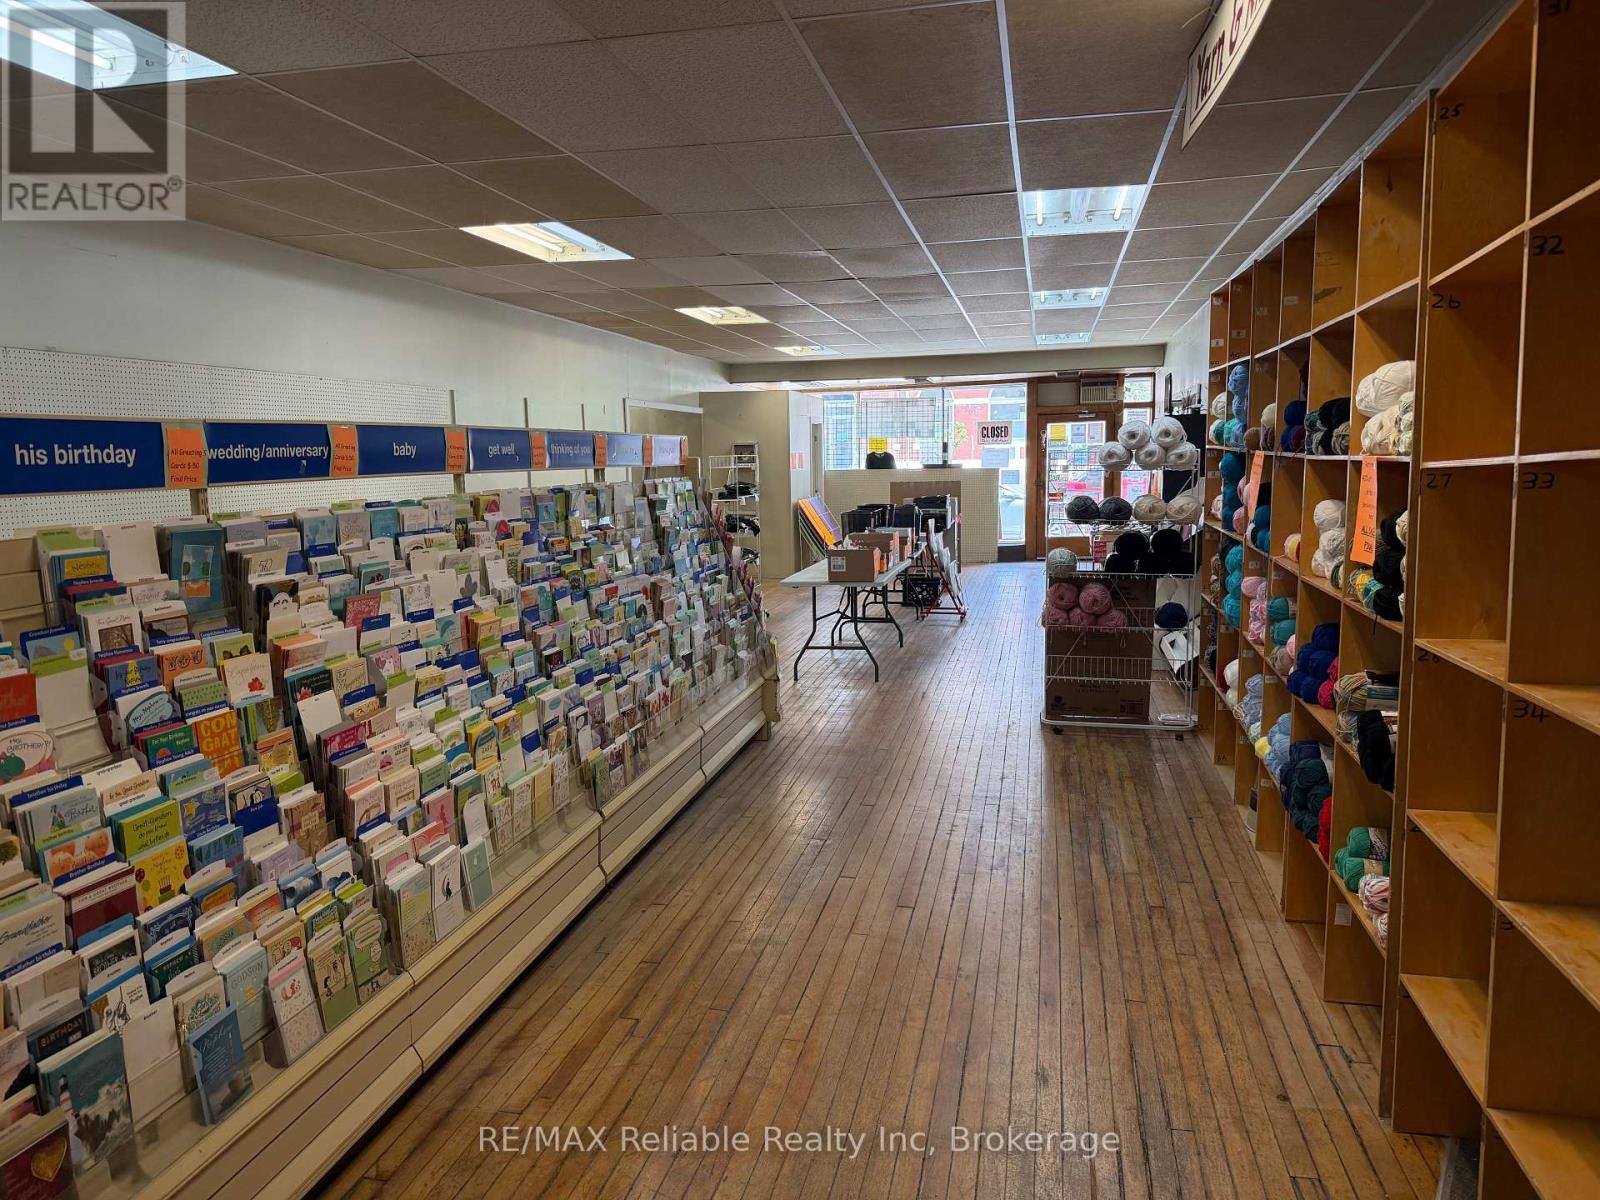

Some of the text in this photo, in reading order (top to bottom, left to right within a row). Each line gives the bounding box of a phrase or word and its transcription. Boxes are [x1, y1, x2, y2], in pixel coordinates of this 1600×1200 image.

[1195, 29, 1226, 113] Yarn
[1440, 104, 1463, 120] 25
[1532, 235, 1564, 255] 32
[1432, 294, 1461, 309] 26
[981, 425, 1009, 438] CLOSED
[15, 443, 136, 468] his birthday
[208, 442, 329, 461] wedding/anniversary
[393, 442, 417, 458] baby
[488, 443, 515, 458] get well
[551, 442, 573, 456] thinking
[574, 443, 580, 455] of
[580, 445, 591, 457] you
[1426, 473, 1452, 488] 27
[1522, 472, 1555, 489] 33
[1512, 699, 1549, 722] 34
